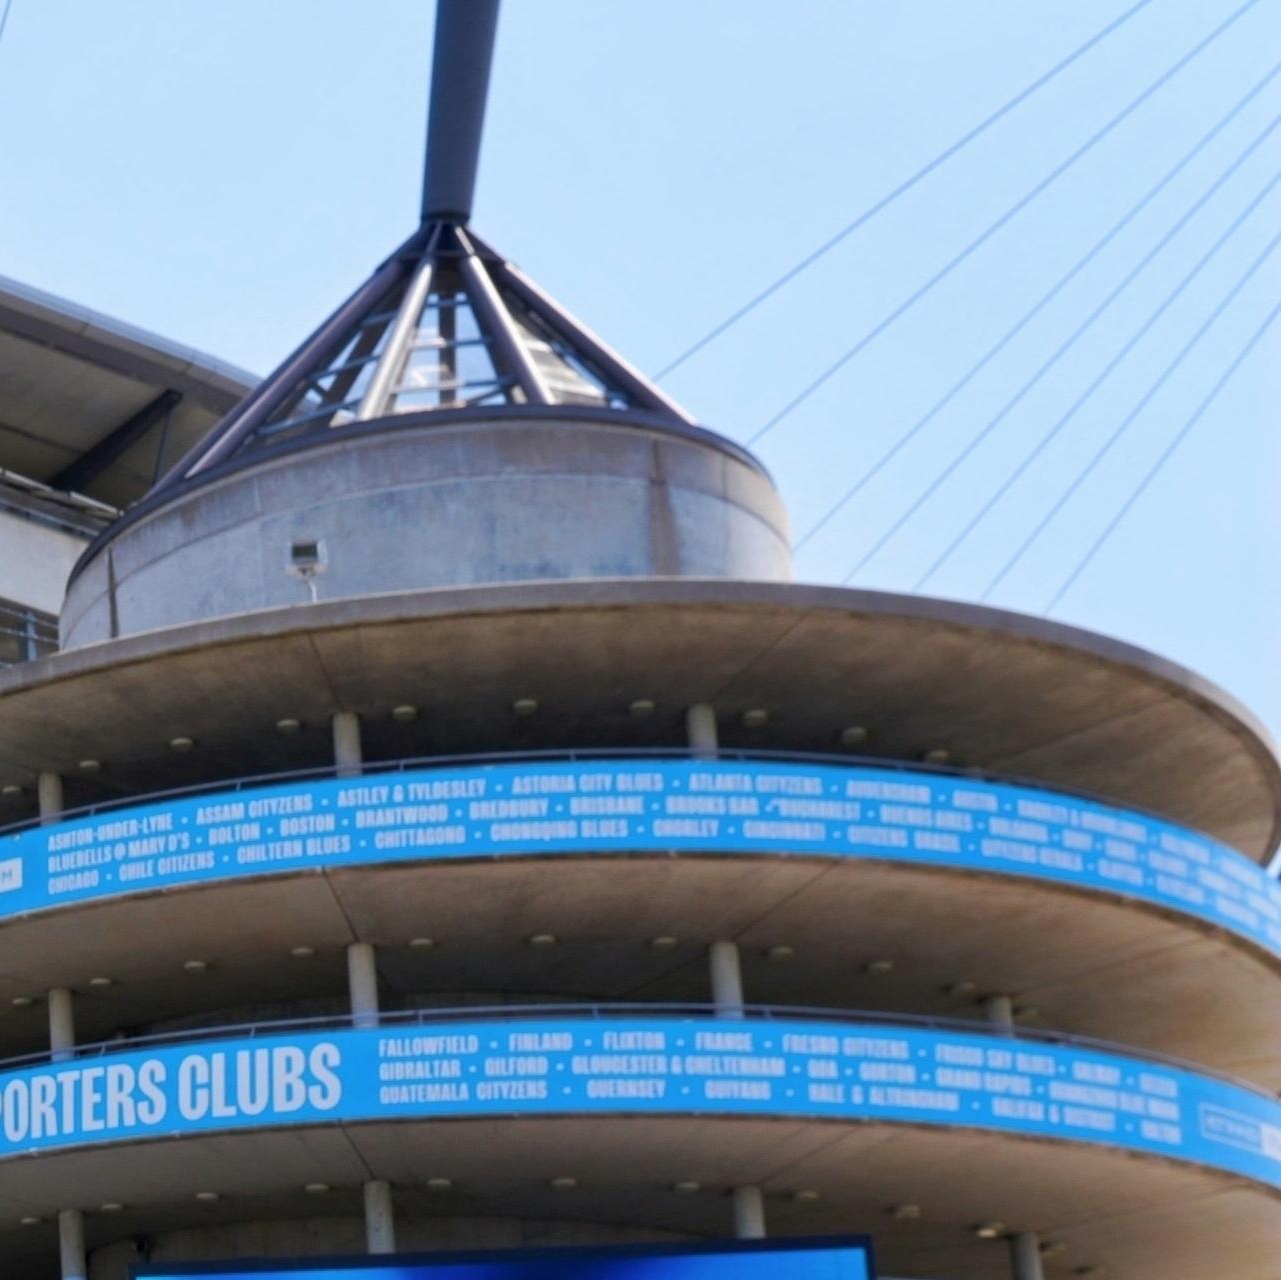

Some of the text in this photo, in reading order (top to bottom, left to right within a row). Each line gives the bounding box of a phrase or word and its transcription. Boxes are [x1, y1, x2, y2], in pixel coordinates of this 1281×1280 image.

[48, 813, 173, 851] ASHTON-UNDER-LYNE
[196, 802, 244, 825] ASSAM
[338, 785, 389, 808] ASTLEY
[48, 844, 112, 873] BLUEBELLS
[128, 836, 164, 857] MARY
[356, 804, 448, 828] BRANTWOOD
[119, 860, 154, 882] CHILE
[306, 834, 351, 858] BLUES
[379, 1034, 478, 1057] FALLOWFIELD
[177, 1042, 342, 1121] CLUBS
[379, 1059, 461, 1081] GIBRALTAR
[380, 1081, 470, 1105] GUATEMALA
